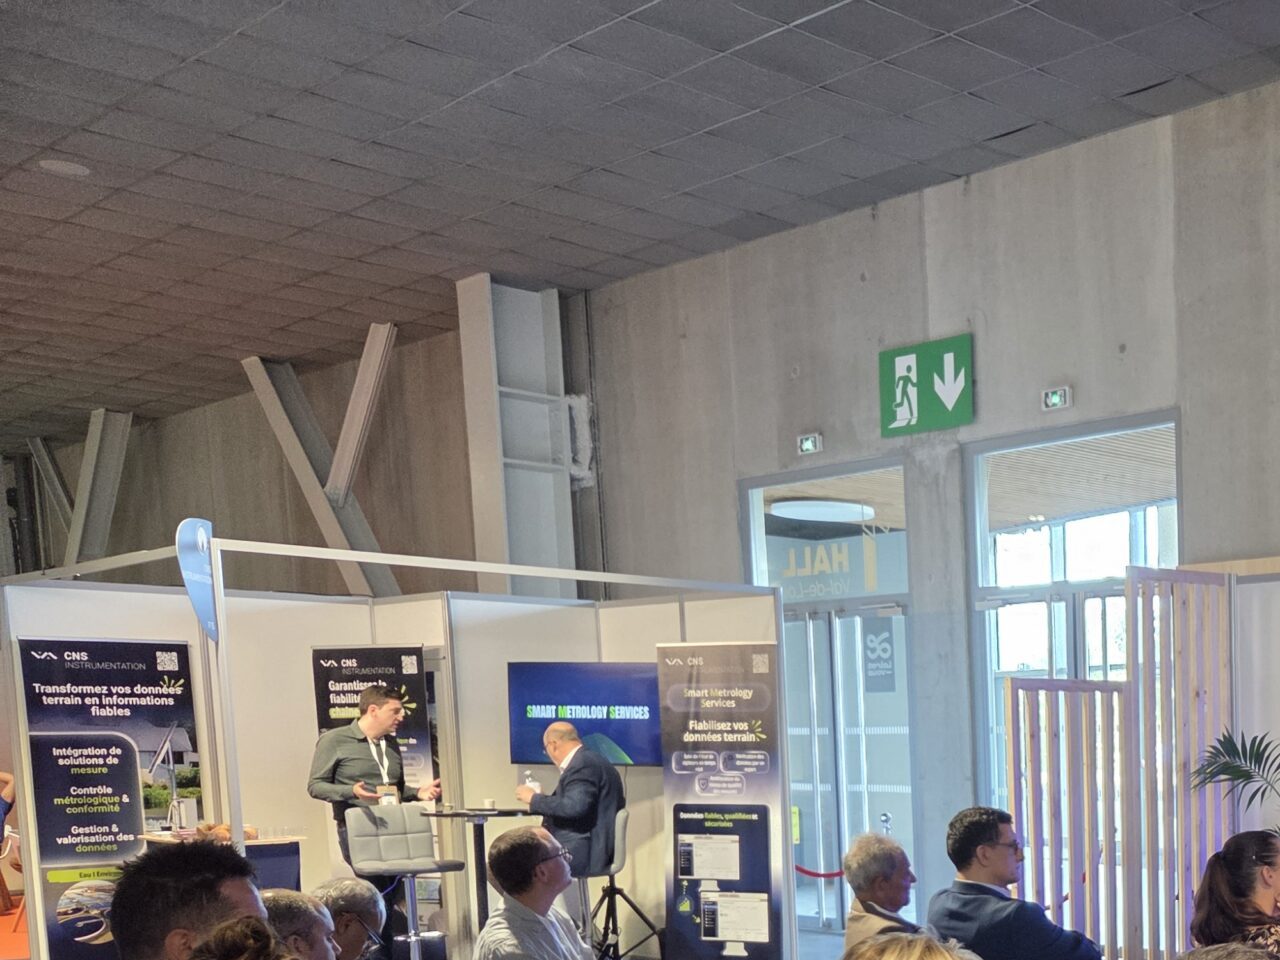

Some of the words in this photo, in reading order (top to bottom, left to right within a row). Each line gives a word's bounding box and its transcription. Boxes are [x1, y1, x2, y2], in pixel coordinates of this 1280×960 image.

[64, 651, 89, 661] CNS
[687, 656, 704, 666] CNS
[64, 661, 146, 670] INSTRUMENTATION
[341, 659, 357, 667] CNS
[32, 683, 108, 694] Transformez
[110, 685, 131, 694] vos
[133, 683, 182, 695] données
[683, 688, 709, 698] Smart
[710, 688, 753, 699] Metrology
[42, 695, 82, 705] terrain
[84, 696, 100, 705] en
[102, 695, 175, 705] informations
[700, 698, 736, 708] Services
[90, 706, 131, 716] fiables
[526, 704, 556, 718] SMART
[558, 705, 608, 719] METROLOGY
[609, 706, 650, 719] SERVICES
[689, 720, 732, 730] Fiabilisez
[732, 722, 749, 730] vos
[683, 731, 721, 742] données
[52, 747, 107, 757] Intégration
[109, 746, 122, 755] de
[58, 756, 104, 765] solutions
[106, 756, 119, 764] de
[71, 766, 108, 774] mesure
[70, 785, 113, 795] Contrôle
[53, 796, 120, 806] métrologique
[121, 794, 130, 803] &
[66, 803, 120, 814] conformité
[71, 824, 109, 834] Gestion
[111, 824, 119, 832] &
[56, 834, 115, 844] valorisation
[116, 833, 135, 842] des
[75, 843, 118, 853] données
